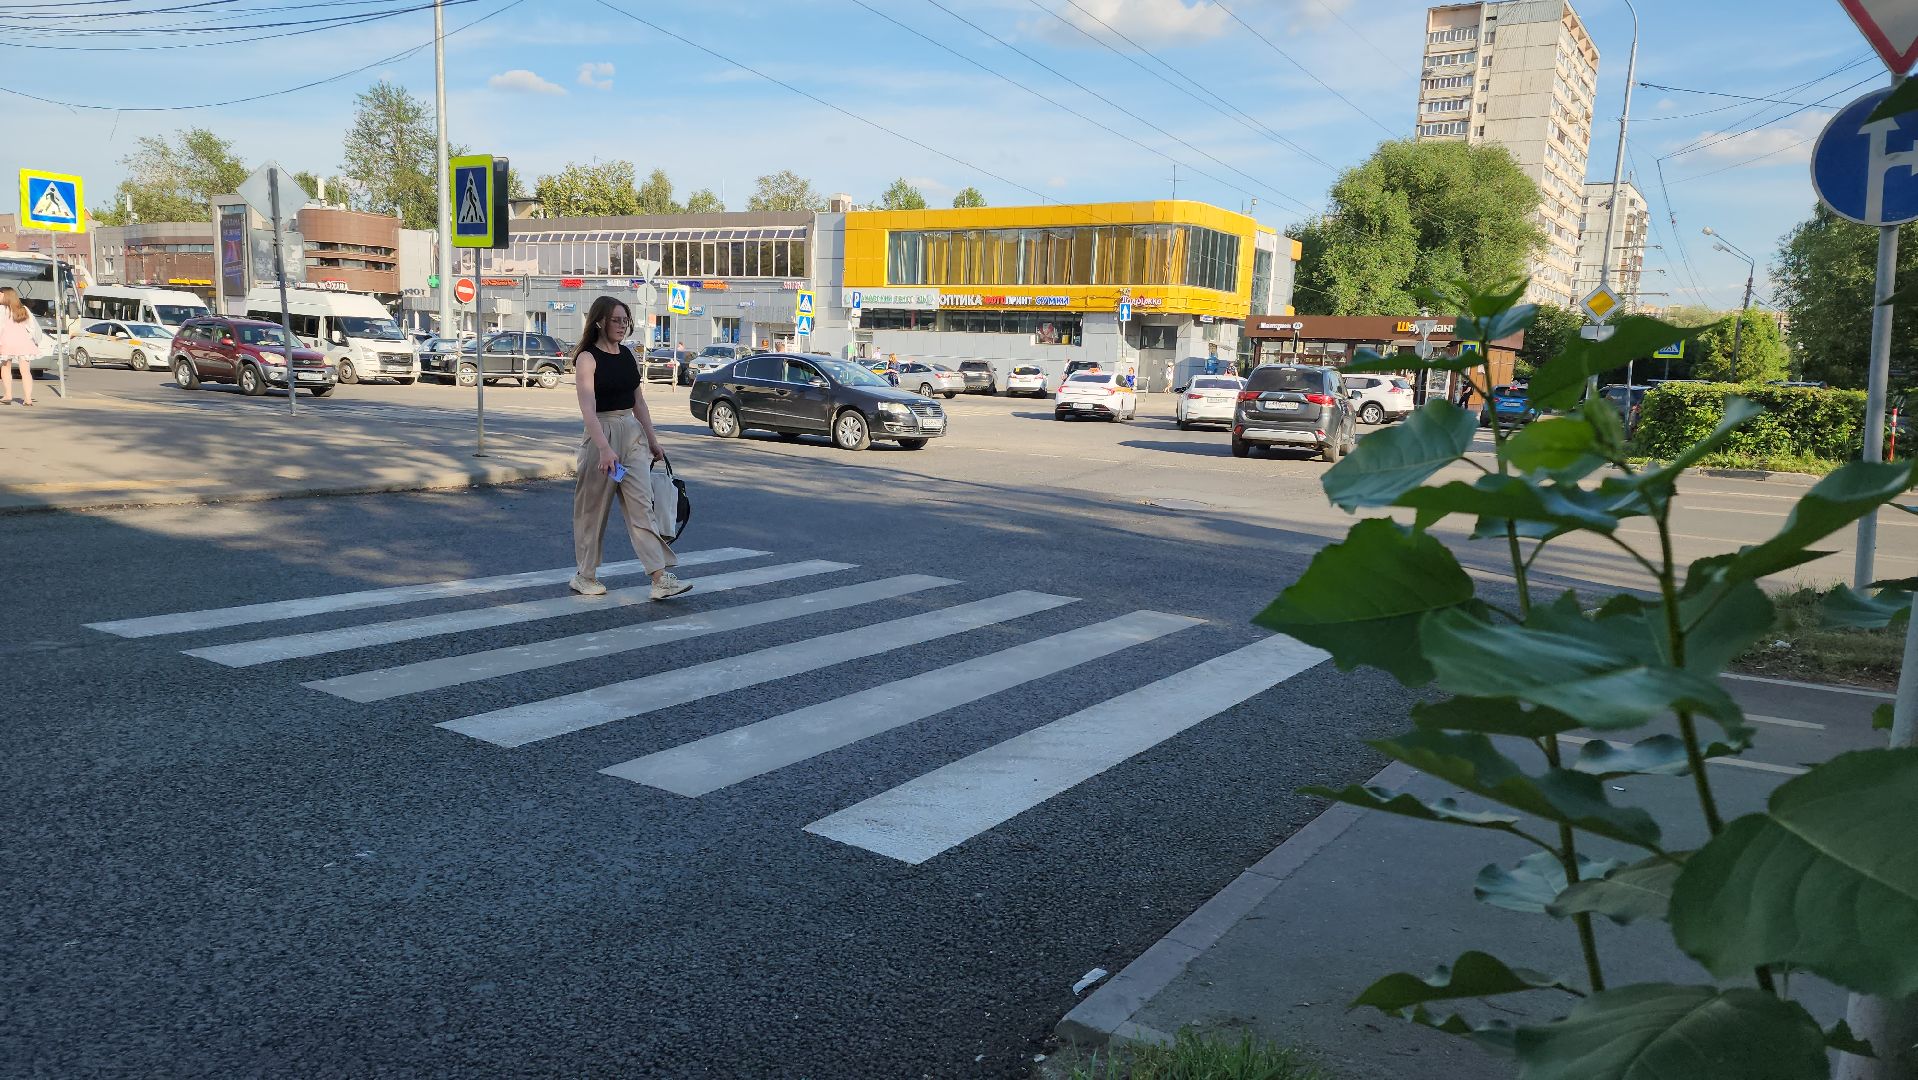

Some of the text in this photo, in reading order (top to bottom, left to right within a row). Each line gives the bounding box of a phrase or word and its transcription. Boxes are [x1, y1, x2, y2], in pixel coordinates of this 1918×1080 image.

[939, 294, 1070, 306] ОПТИКА ФОТОПРИНТ СУМКИ
